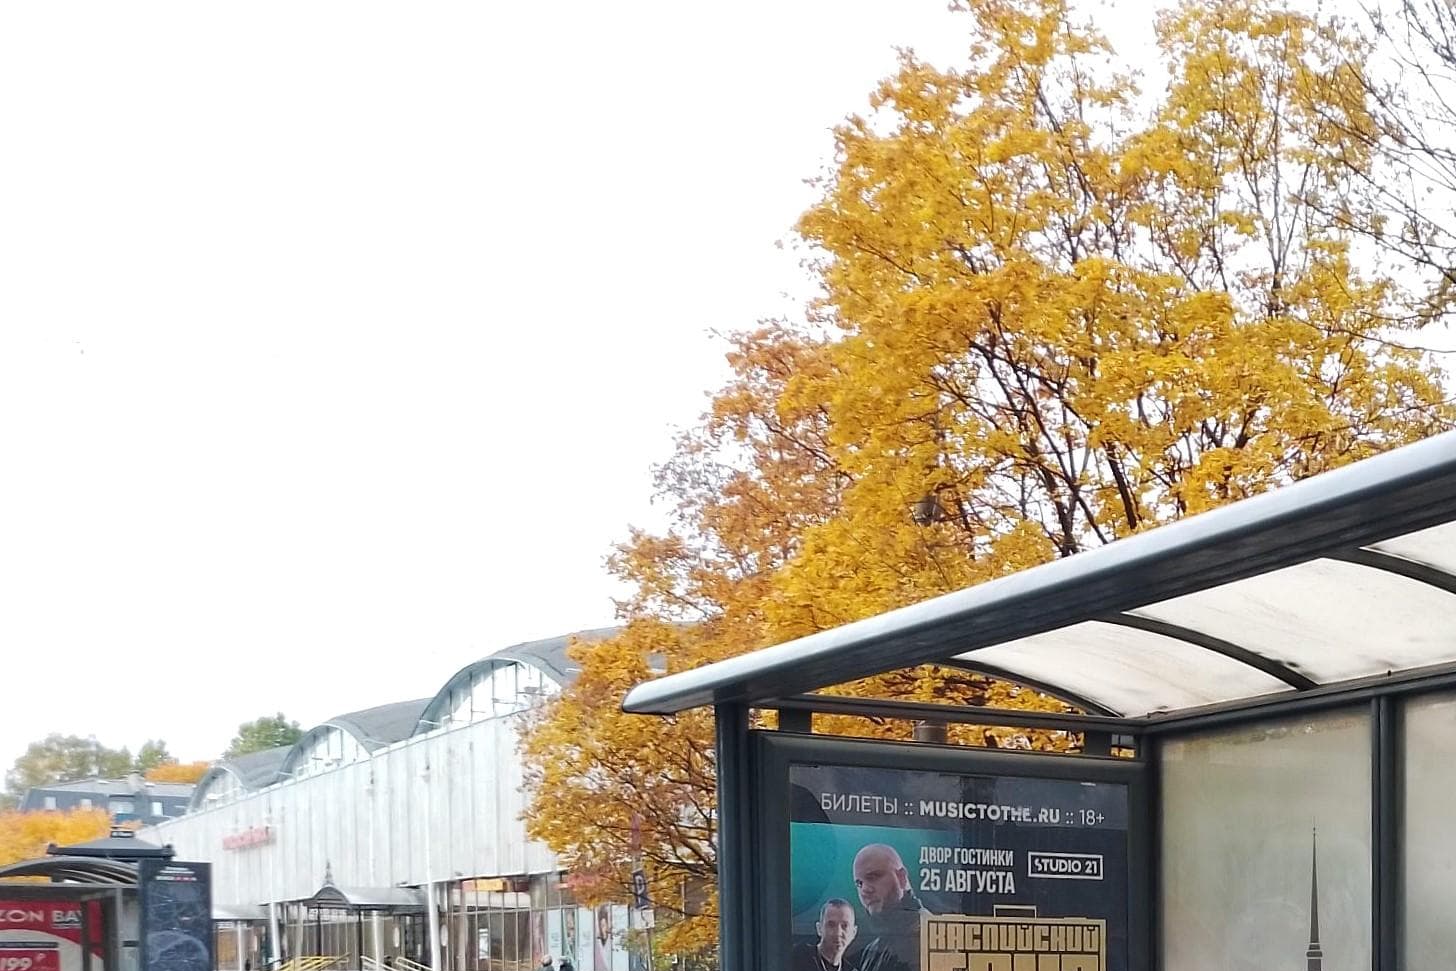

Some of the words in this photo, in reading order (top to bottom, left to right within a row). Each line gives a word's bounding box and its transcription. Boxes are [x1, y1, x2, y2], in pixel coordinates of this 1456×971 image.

[821, 793, 898, 815] БИЛЕТЫ
[919, 800, 1060, 824] MUSICTOTHE.RU
[1079, 808, 1105, 825] 18+
[919, 847, 952, 865] ДВОР
[954, 848, 1014, 867] ГОСТИНКИ
[1034, 858, 1083, 874] STUDIO
[1084, 862, 1098, 875] 21
[919, 869, 941, 892] 25
[945, 869, 1016, 894] АВГУСТА
[929, 922, 1100, 951] КАСПИЙСКИЙ
